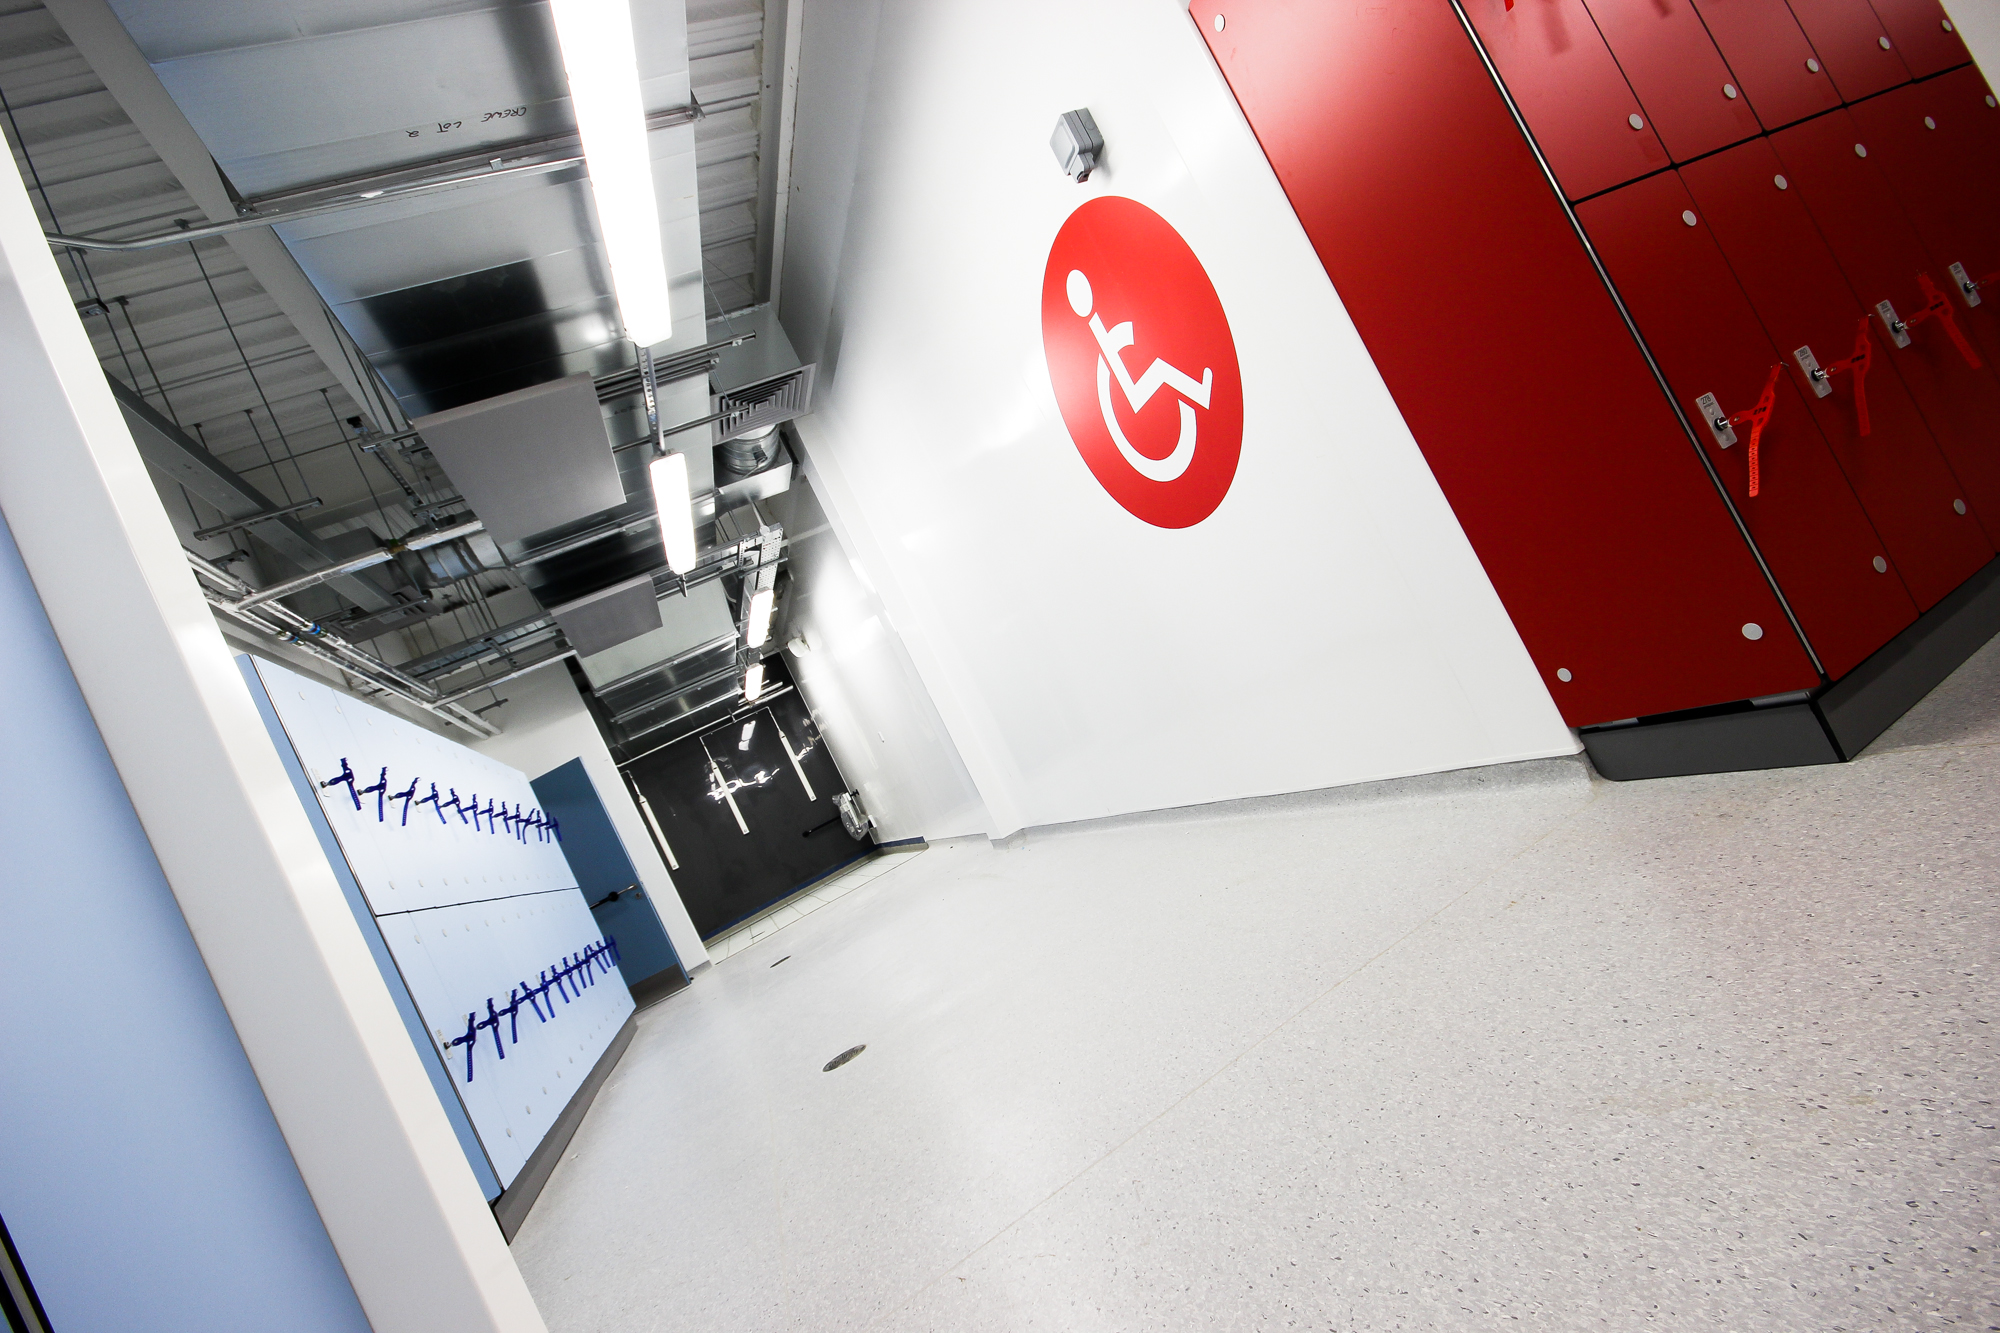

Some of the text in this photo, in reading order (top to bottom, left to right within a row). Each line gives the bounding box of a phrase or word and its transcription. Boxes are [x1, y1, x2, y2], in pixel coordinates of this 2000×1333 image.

[480, 106, 527, 122] CREWE
[436, 120, 462, 133] LOT
[1700, 394, 1712, 405] 278
